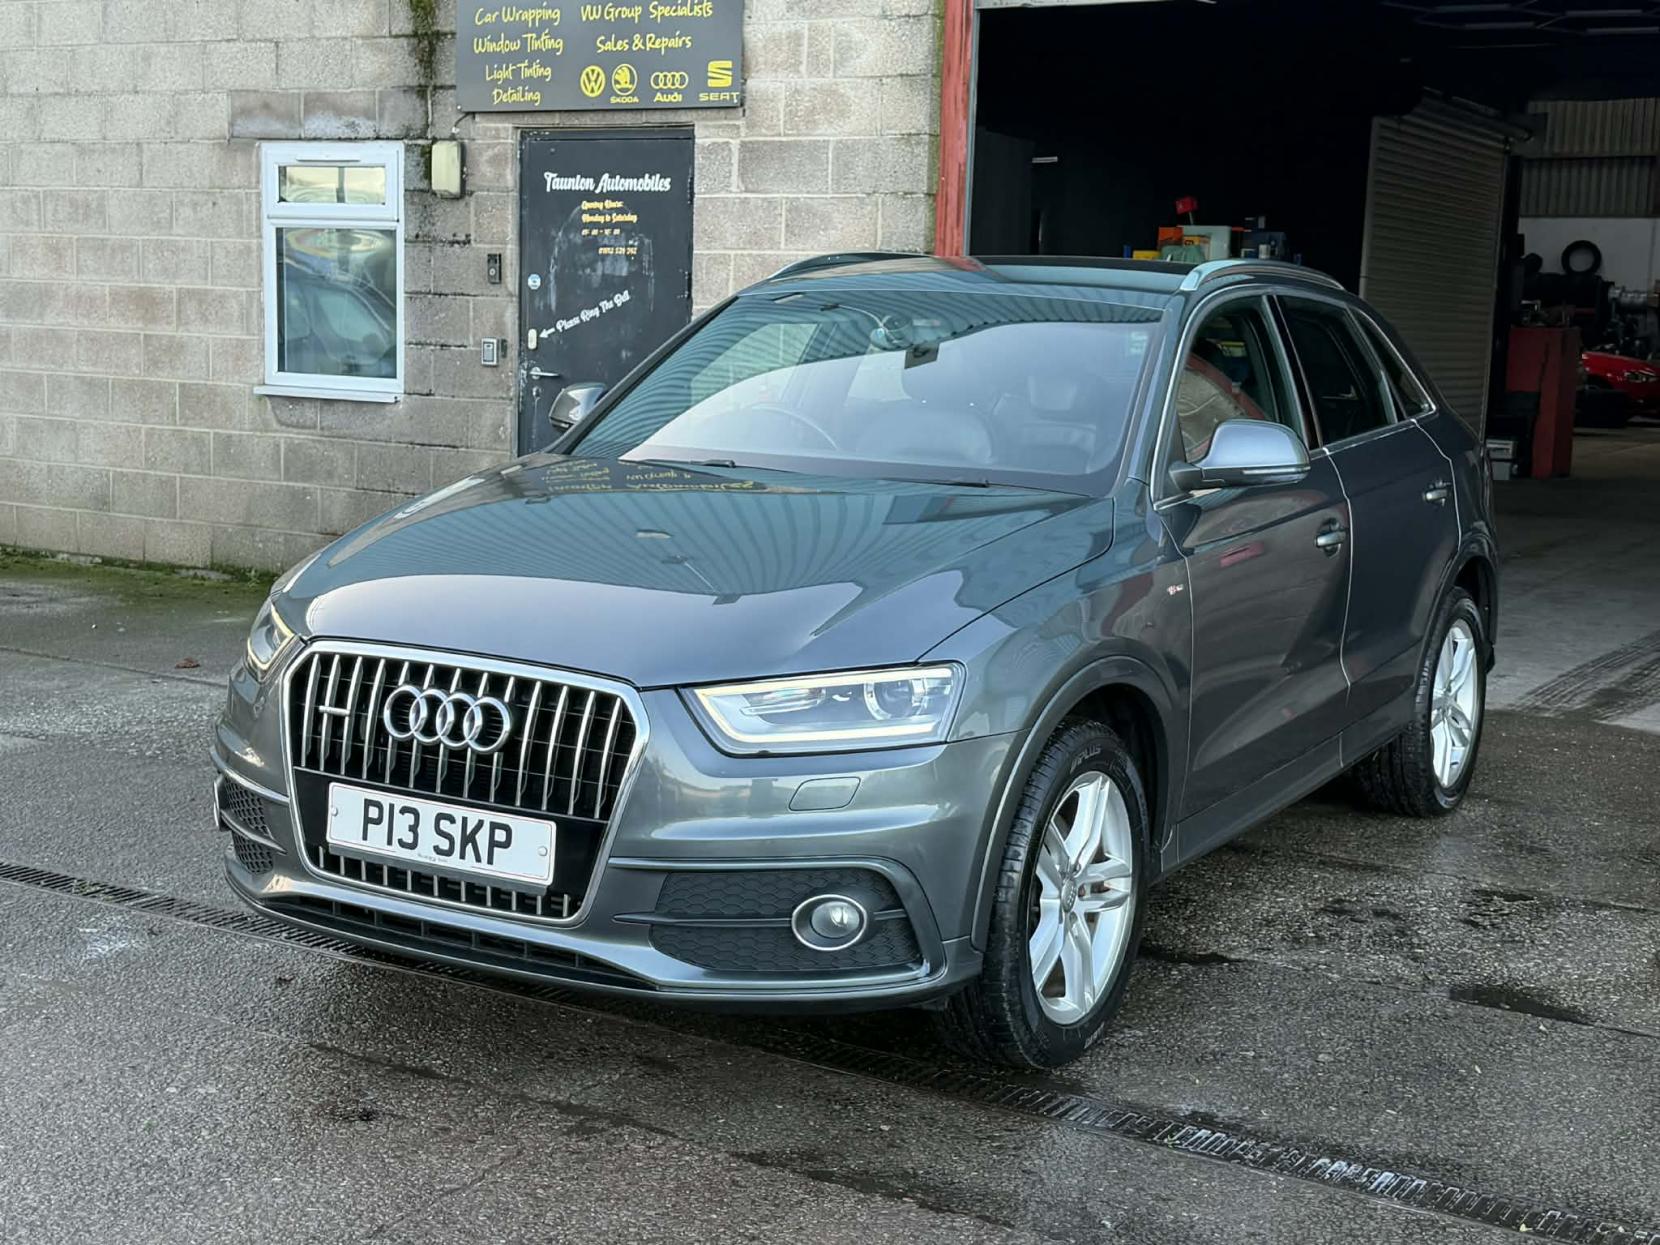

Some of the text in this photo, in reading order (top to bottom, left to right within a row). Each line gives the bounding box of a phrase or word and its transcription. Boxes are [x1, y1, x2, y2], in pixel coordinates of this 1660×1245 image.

[475, 1, 561, 28] Car Wrapping
[581, 0, 713, 24] VW Group Specialists
[473, 28, 564, 55] Window Tinting
[596, 30, 692, 56] Sales & Repairs
[485, 59, 552, 85] Light Tinting
[492, 86, 541, 106] Detailing
[653, 91, 683, 103] Audi
[699, 91, 740, 104] SEAT
[543, 171, 671, 194] Taunton Automobiles
[556, 289, 630, 333] Please Ring The Bell
[361, 798, 513, 865] P13 SKP
